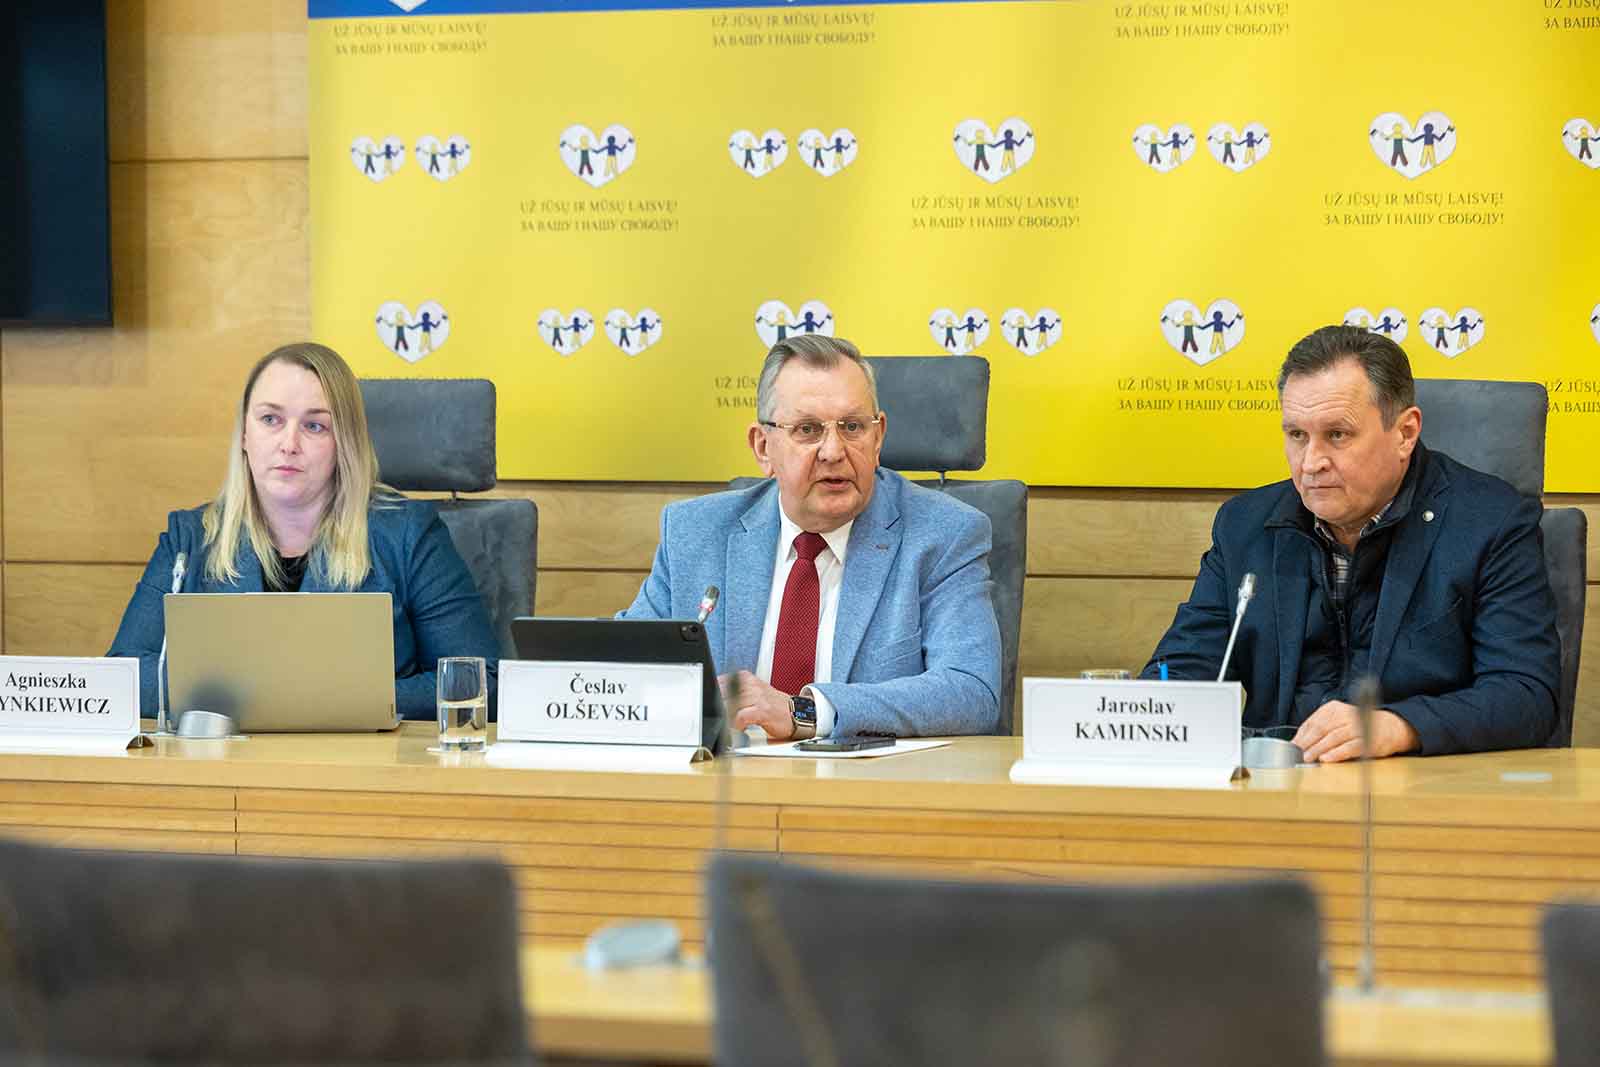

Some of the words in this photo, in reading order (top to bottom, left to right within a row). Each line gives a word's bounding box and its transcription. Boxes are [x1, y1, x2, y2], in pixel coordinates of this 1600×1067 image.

[1174, 5, 1187, 17] IR
[968, 197, 980, 209] IR
[1324, 192, 1344, 206] UŽ
[1348, 192, 1380, 208] JŪSŲ
[1385, 193, 1398, 205] IR
[1403, 191, 1441, 207] MŪSŲ
[1448, 192, 1504, 207] LAISVĘ!
[1324, 213, 1340, 224] ЗА
[1343, 213, 1383, 224] ВАШУ
[1394, 213, 1434, 224] НАШУ
[1439, 213, 1504, 225] СВОБОДУ!
[1176, 379, 1190, 391] IR
[1237, 378, 1278, 391] LAISV
[1228, 399, 1281, 412] СВОБОД
[5, 672, 87, 691] Agnieszka
[569, 672, 627, 695] Česlav
[0, 695, 111, 715] YNKIEWICZ
[546, 699, 649, 722] OLŠEVSKI
[1096, 696, 1176, 715] Jaroslav
[1075, 721, 1189, 743] KAMINSKI
